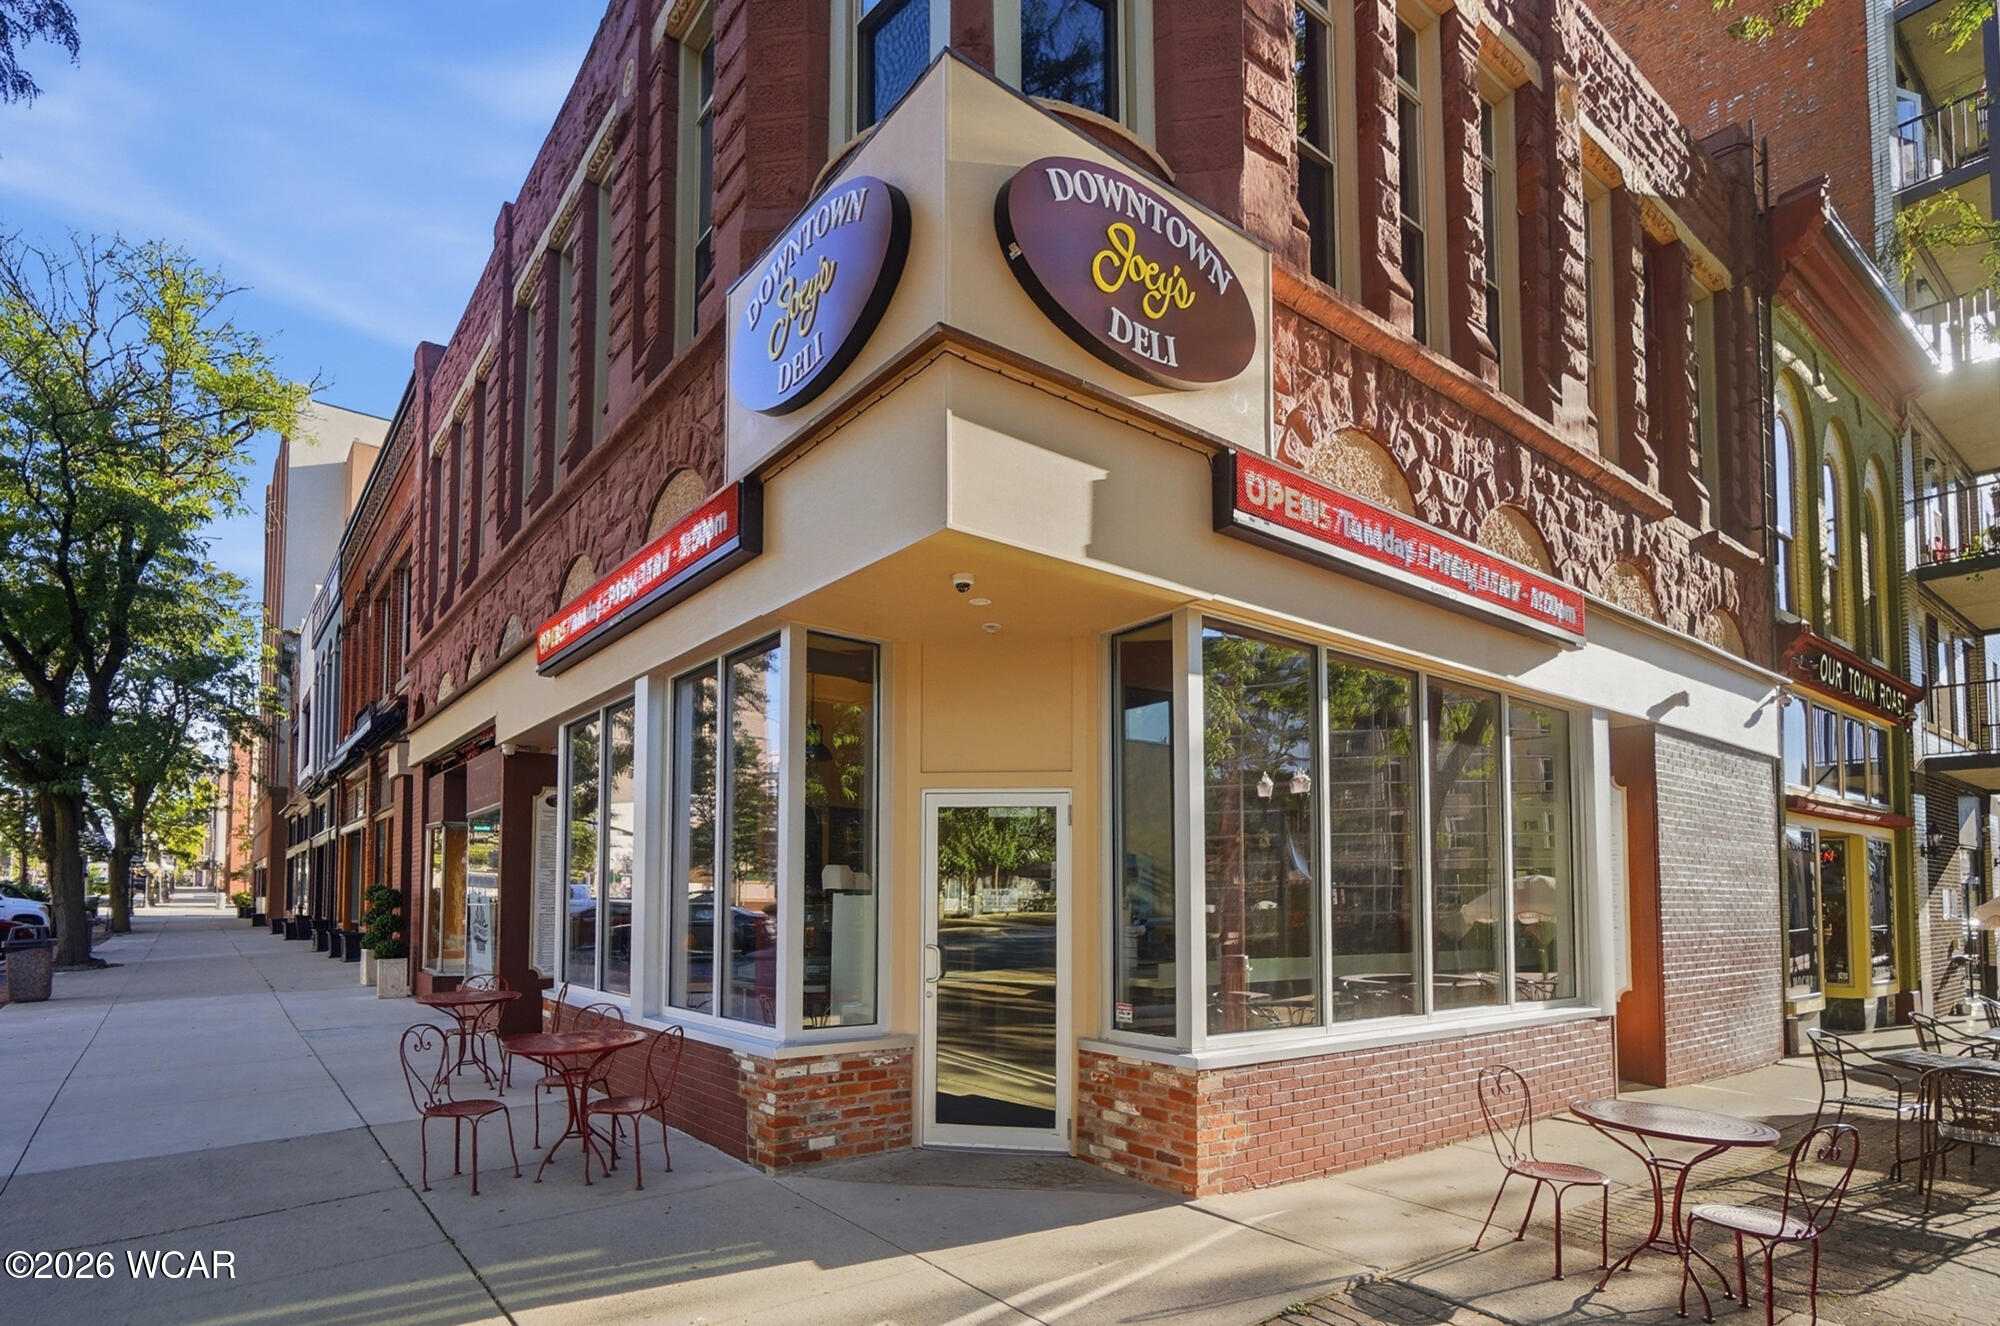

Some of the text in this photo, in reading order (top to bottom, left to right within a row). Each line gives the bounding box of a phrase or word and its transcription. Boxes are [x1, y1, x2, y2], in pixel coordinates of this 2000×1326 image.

[746, 188, 869, 331] DOWNTOWN
[1046, 168, 1233, 295] DOWNTOWN
[1092, 222, 1196, 319] Joey's
[767, 255, 837, 362] Joey's
[1108, 306, 1179, 367] DELI
[777, 332, 824, 394] DELI
[1819, 653, 1907, 715] OUR TOWN ROAST
